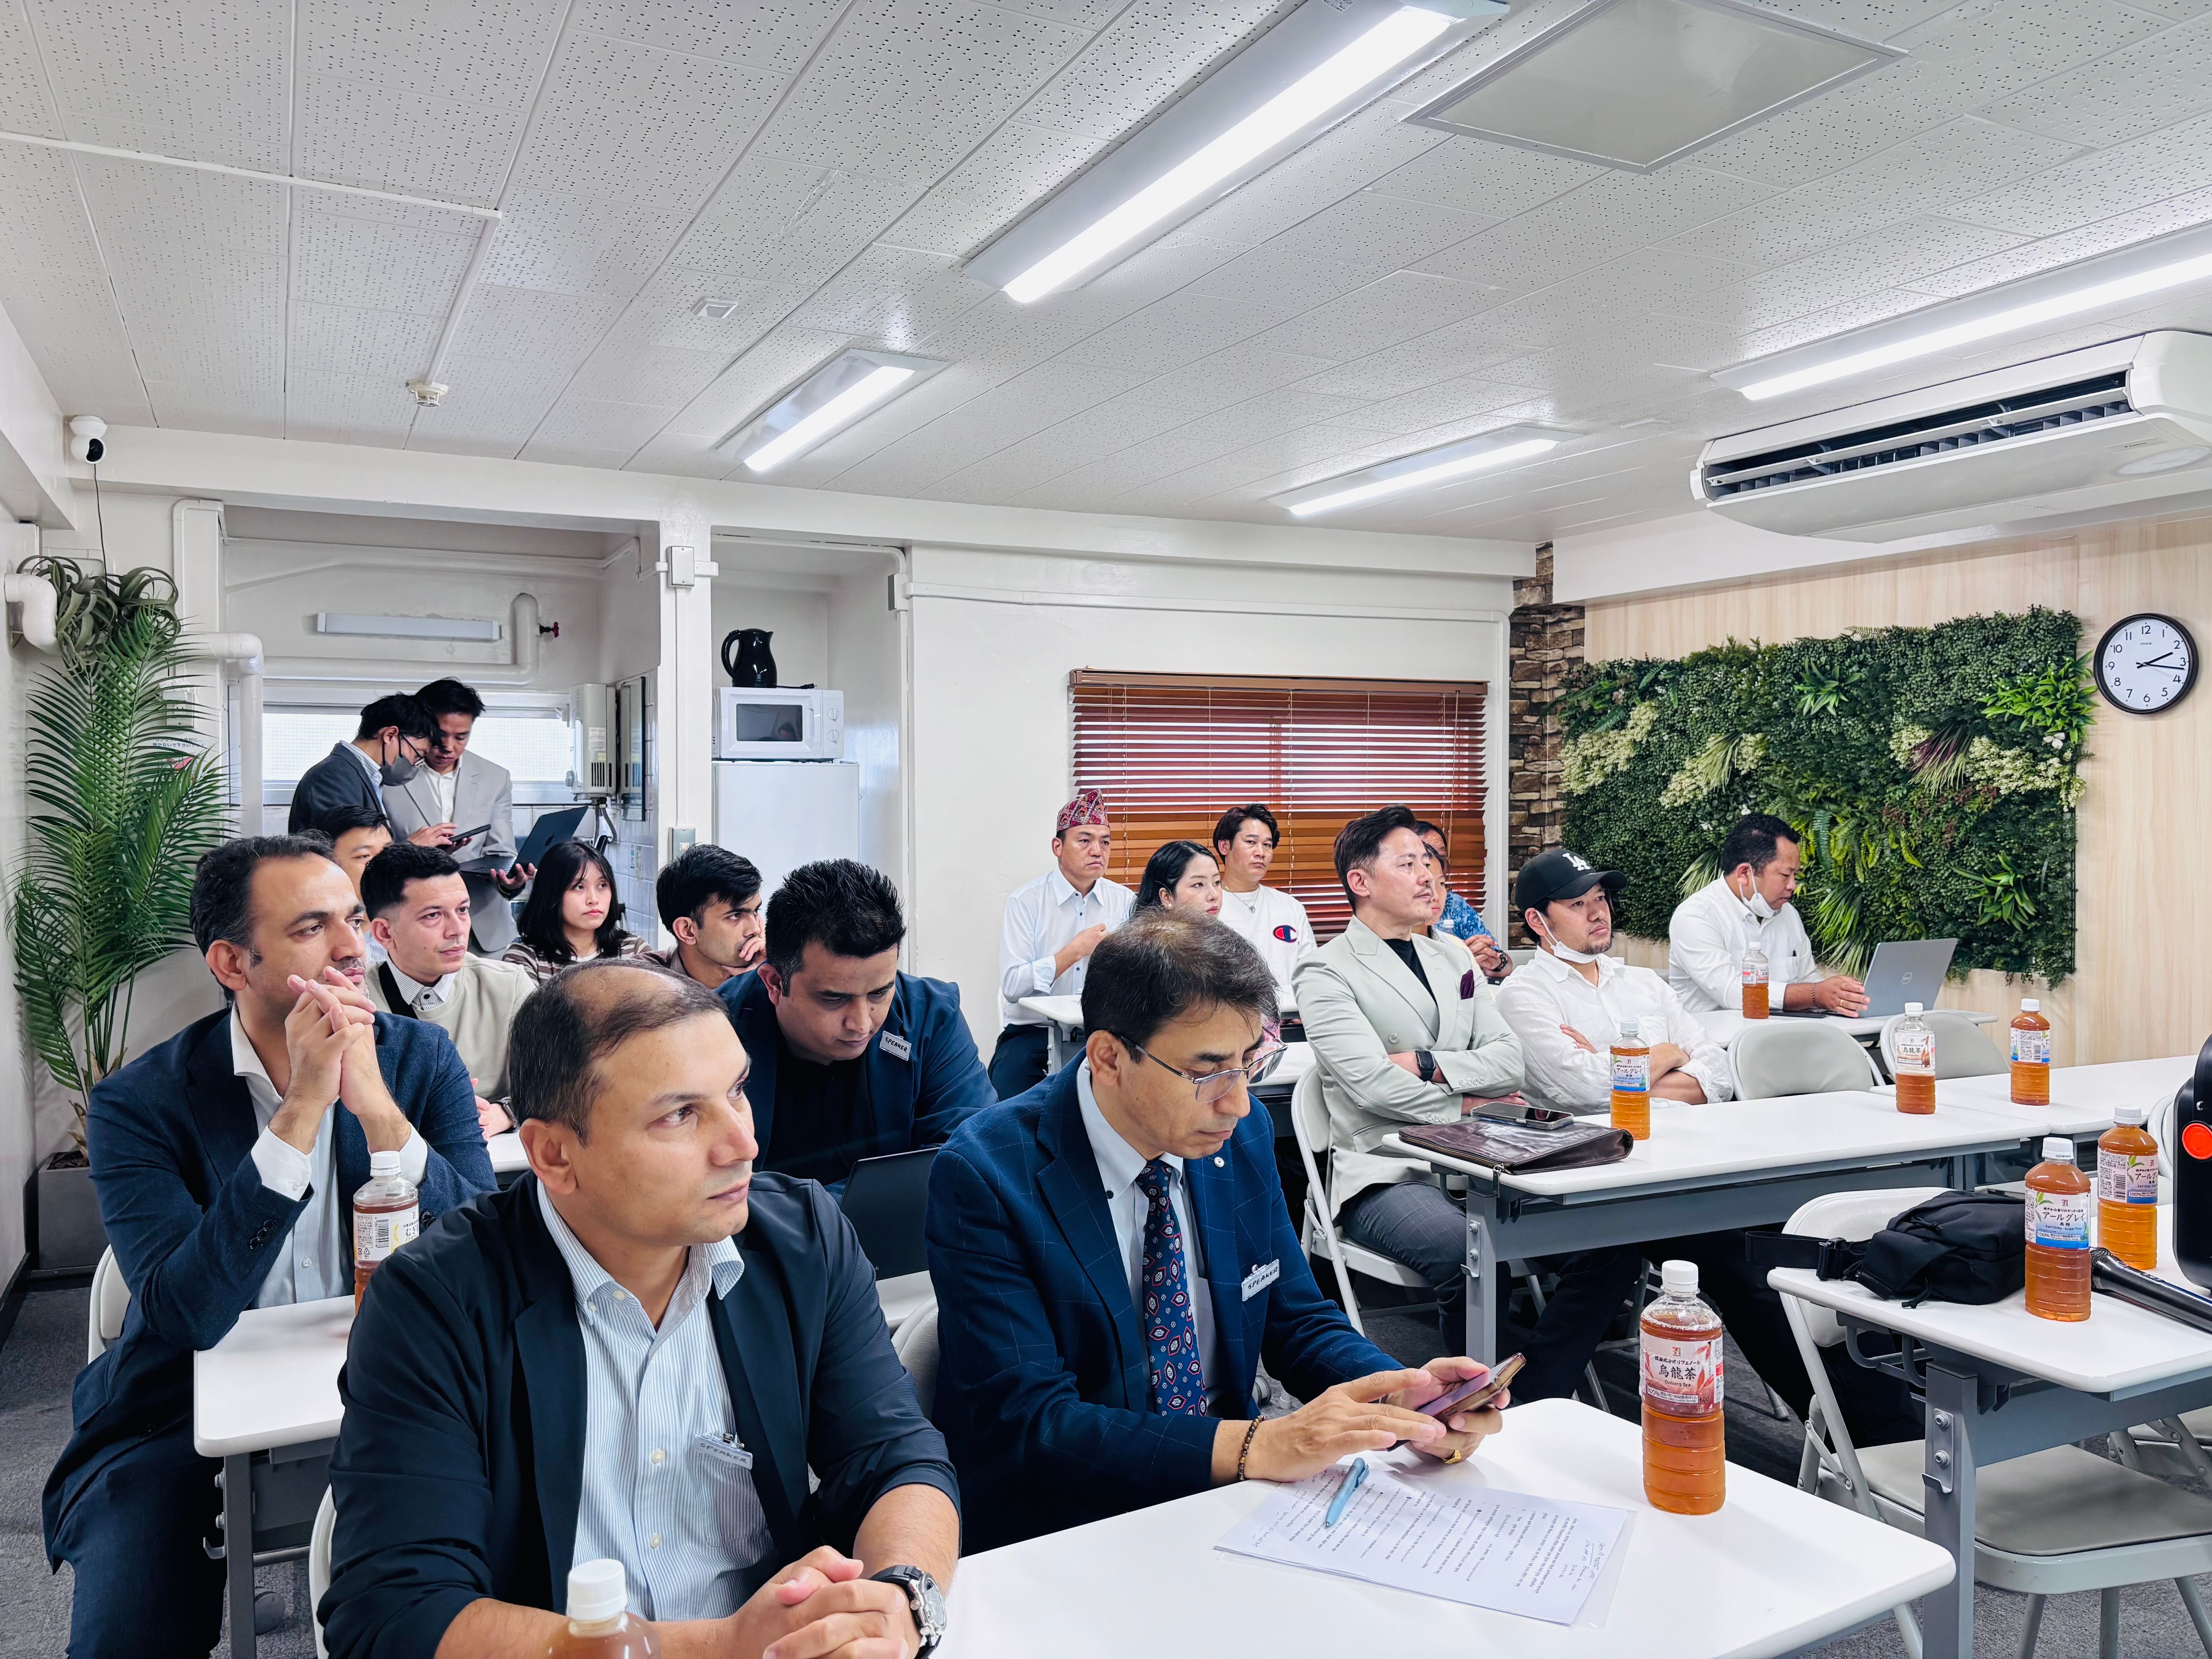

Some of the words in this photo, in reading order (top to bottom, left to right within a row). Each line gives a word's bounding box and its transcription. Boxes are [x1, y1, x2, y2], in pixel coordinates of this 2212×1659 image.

[2142, 625, 2151, 634] 12
[2162, 629, 2164, 637] 1
[2126, 632, 2131, 640] 11
[2114, 644, 2122, 653] 10
[2174, 641, 2180, 649] 2
[2109, 662, 2114, 670] 9
[2180, 658, 2186, 666] 3
[2114, 678, 2121, 686] 8
[2173, 675, 2181, 684] 4
[2126, 689, 2132, 698] 7
[2162, 688, 2167, 696] 5
[2144, 694, 2150, 702] 6
[1562, 853, 1590, 871] LA
[885, 1037, 907, 1053] SPEAKER
[2043, 1212, 2084, 1221] アールグレイ
[1248, 1266, 1278, 1290] SPEAKER
[1659, 1364, 1697, 1380] 烏龍茶
[700, 1443, 747, 1463] SPEAKER
